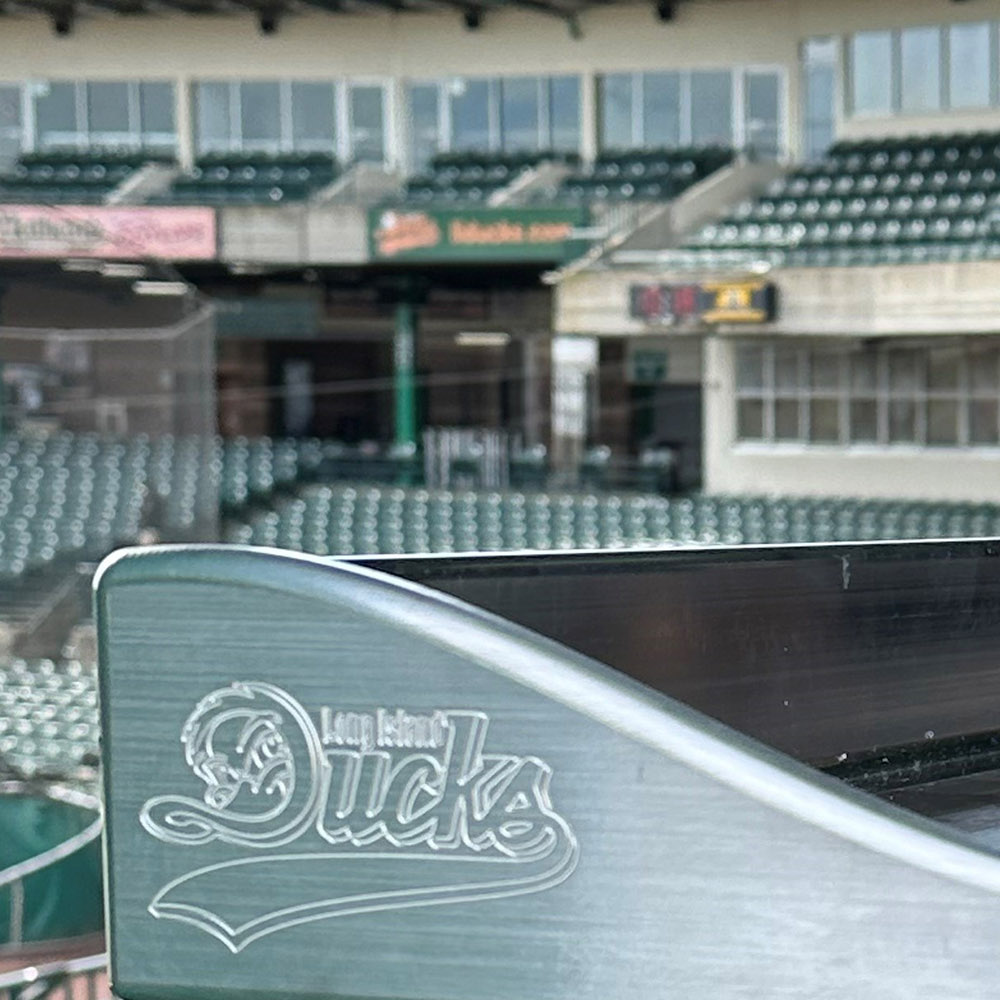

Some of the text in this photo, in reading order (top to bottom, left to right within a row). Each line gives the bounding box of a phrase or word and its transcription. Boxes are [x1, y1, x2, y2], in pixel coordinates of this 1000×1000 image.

[139, 681, 577, 862] Ducks
[321, 706, 446, 751] Long Island
